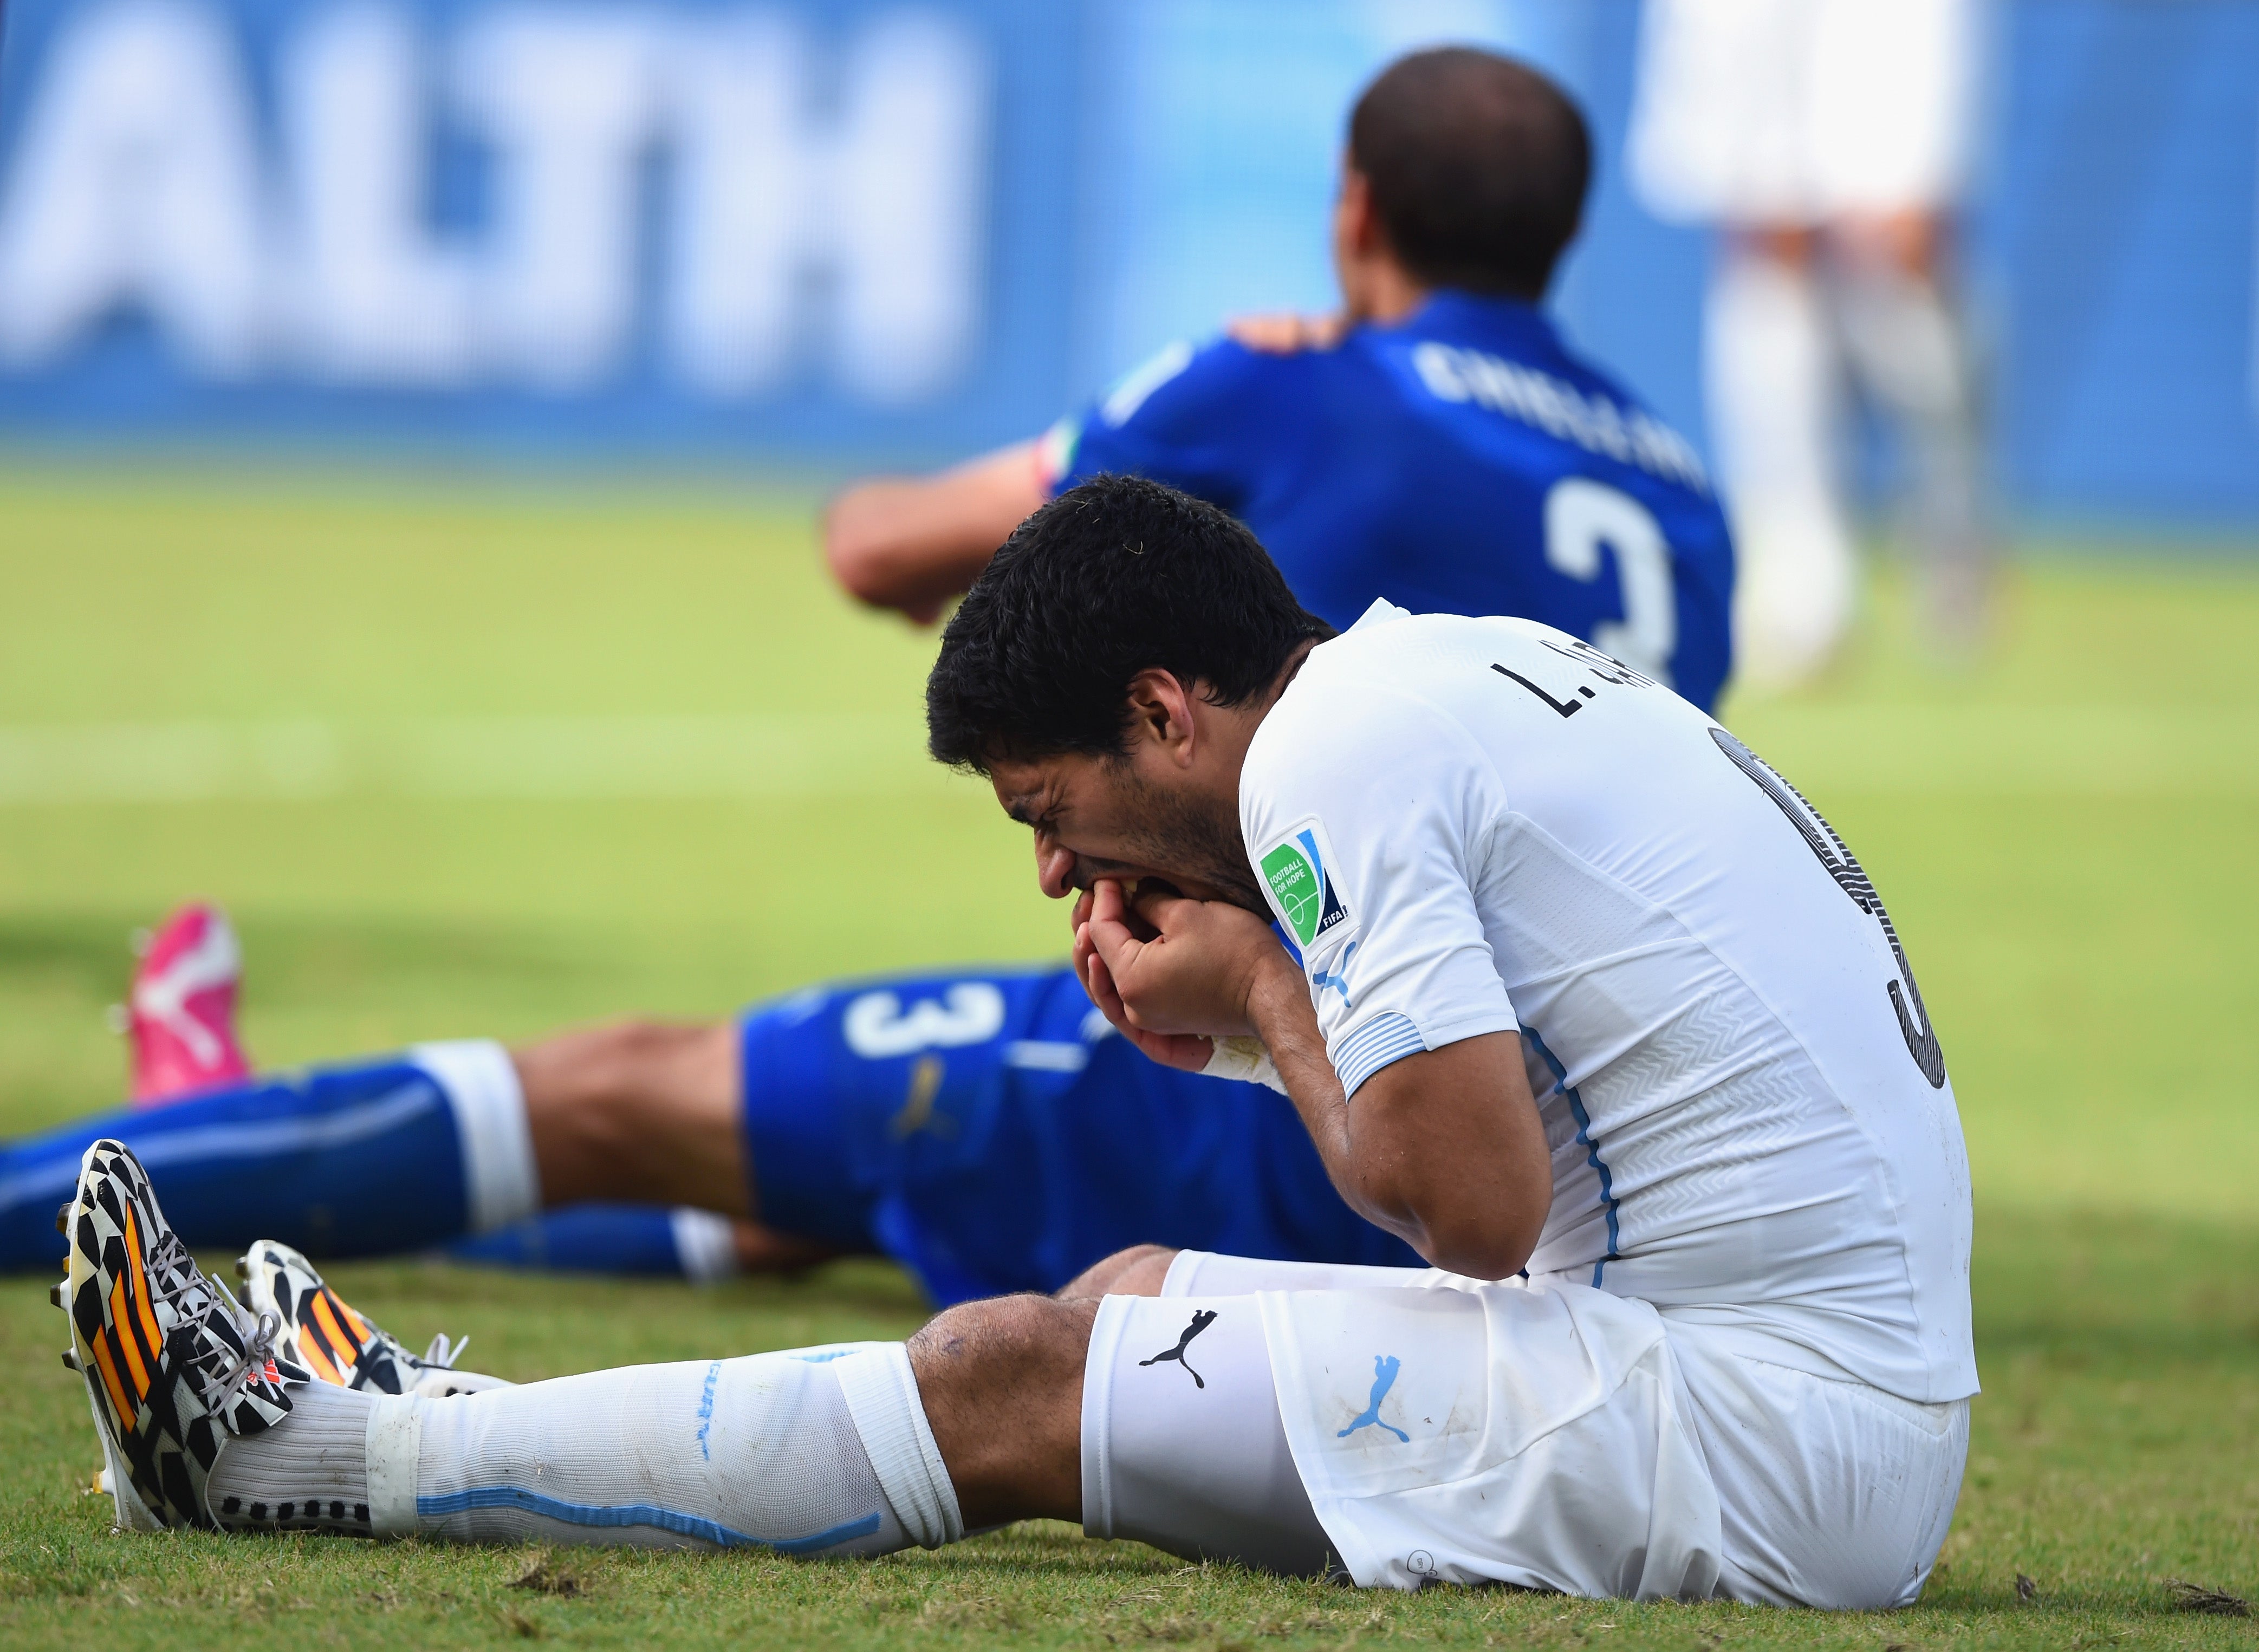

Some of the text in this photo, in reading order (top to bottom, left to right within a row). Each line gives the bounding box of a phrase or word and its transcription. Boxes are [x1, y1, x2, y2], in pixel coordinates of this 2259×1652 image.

[1544, 474, 1677, 689] 3
[1269, 858, 1303, 886] FOOTBALL
[1275, 868, 1306, 896] FOR HOPE
[1322, 910, 1343, 928] FIFA
[1708, 727, 1945, 1089] 9
[842, 981, 1007, 1060] 3
